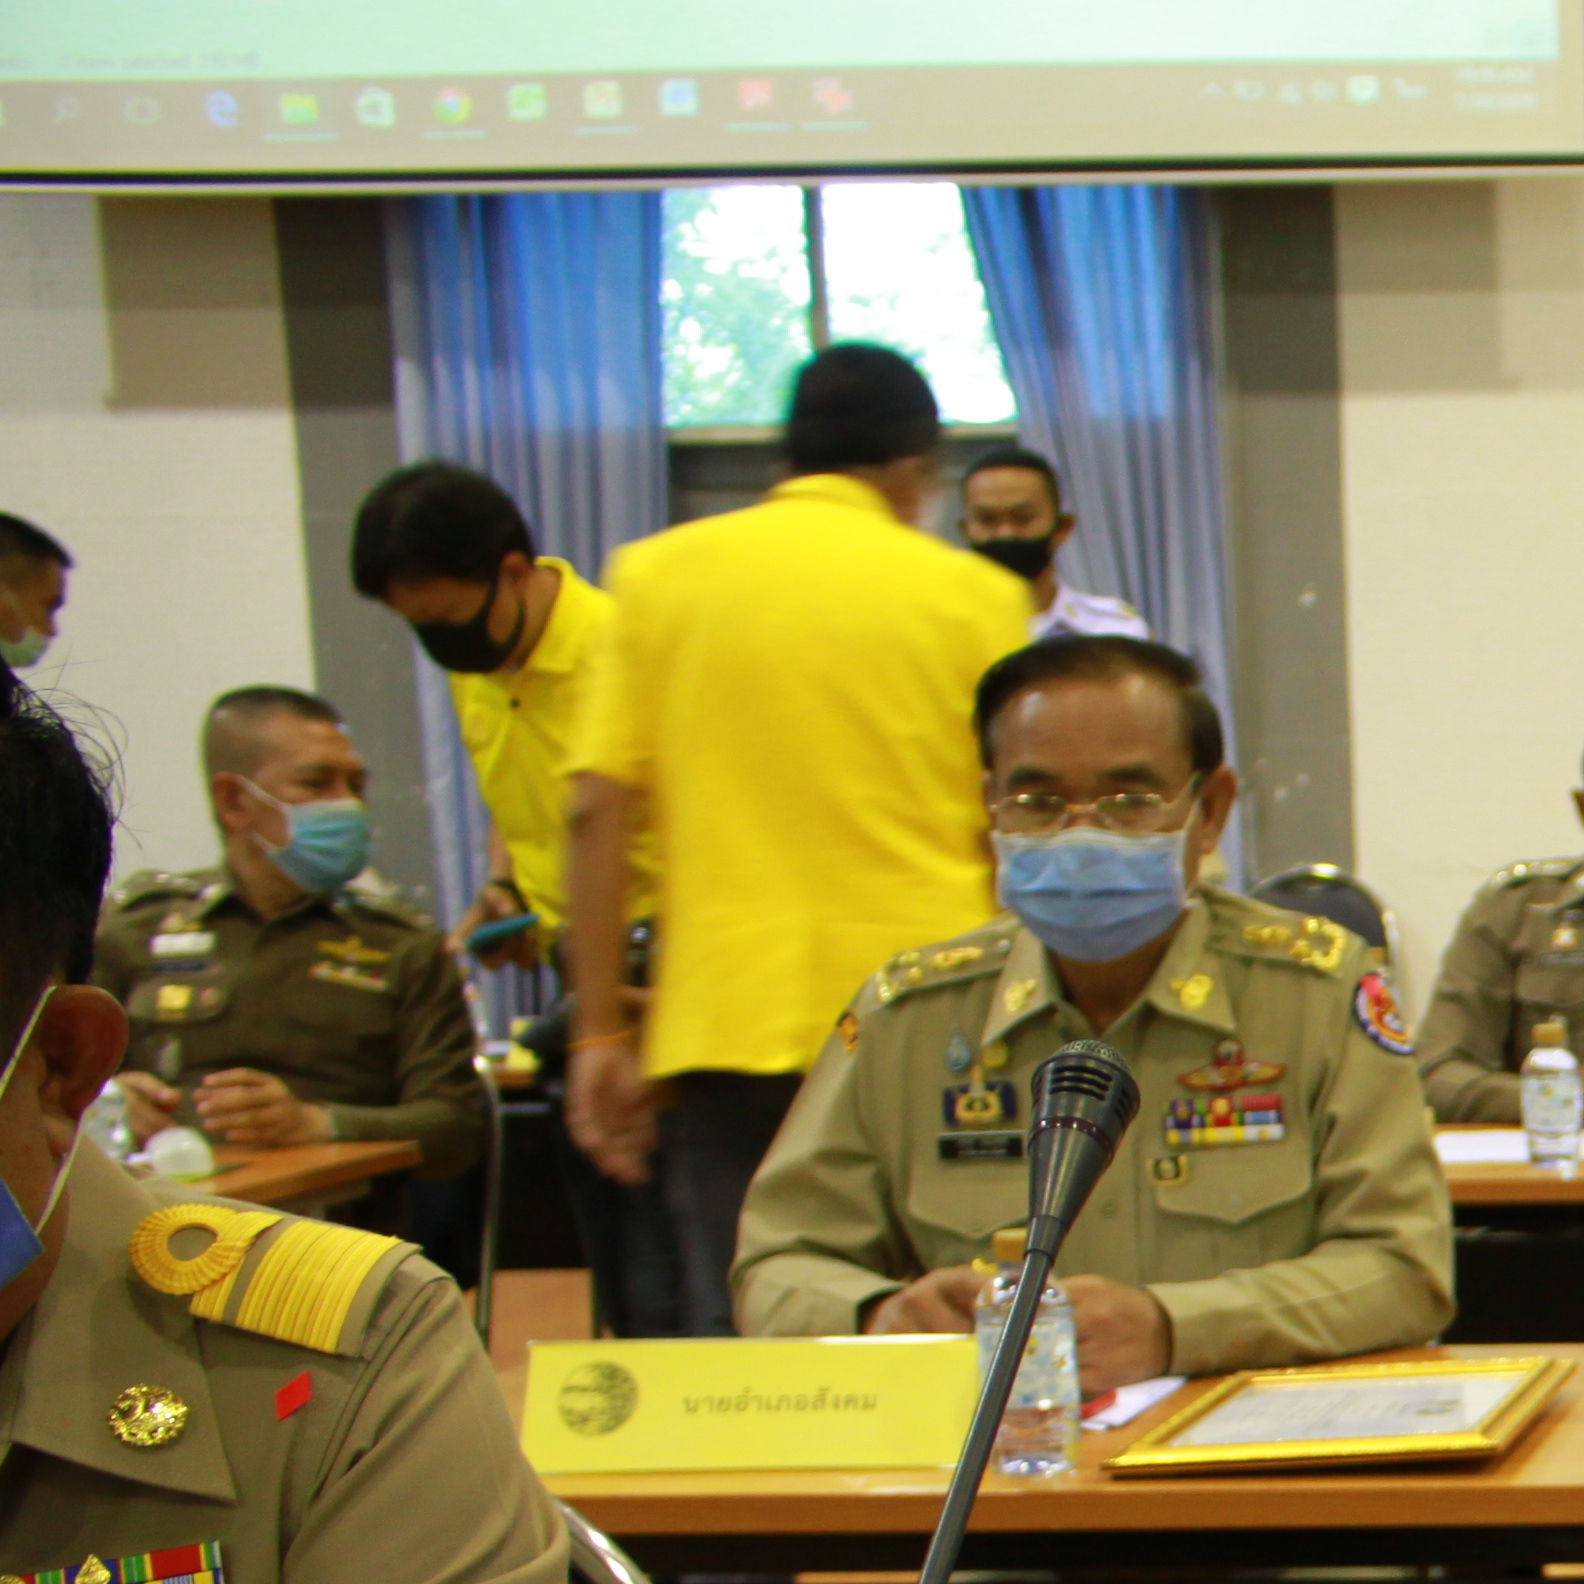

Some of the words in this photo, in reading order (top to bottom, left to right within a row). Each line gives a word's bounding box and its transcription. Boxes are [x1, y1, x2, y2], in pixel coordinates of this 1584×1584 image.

[682, 1386, 879, 1416] นายอำเภอสังคม
